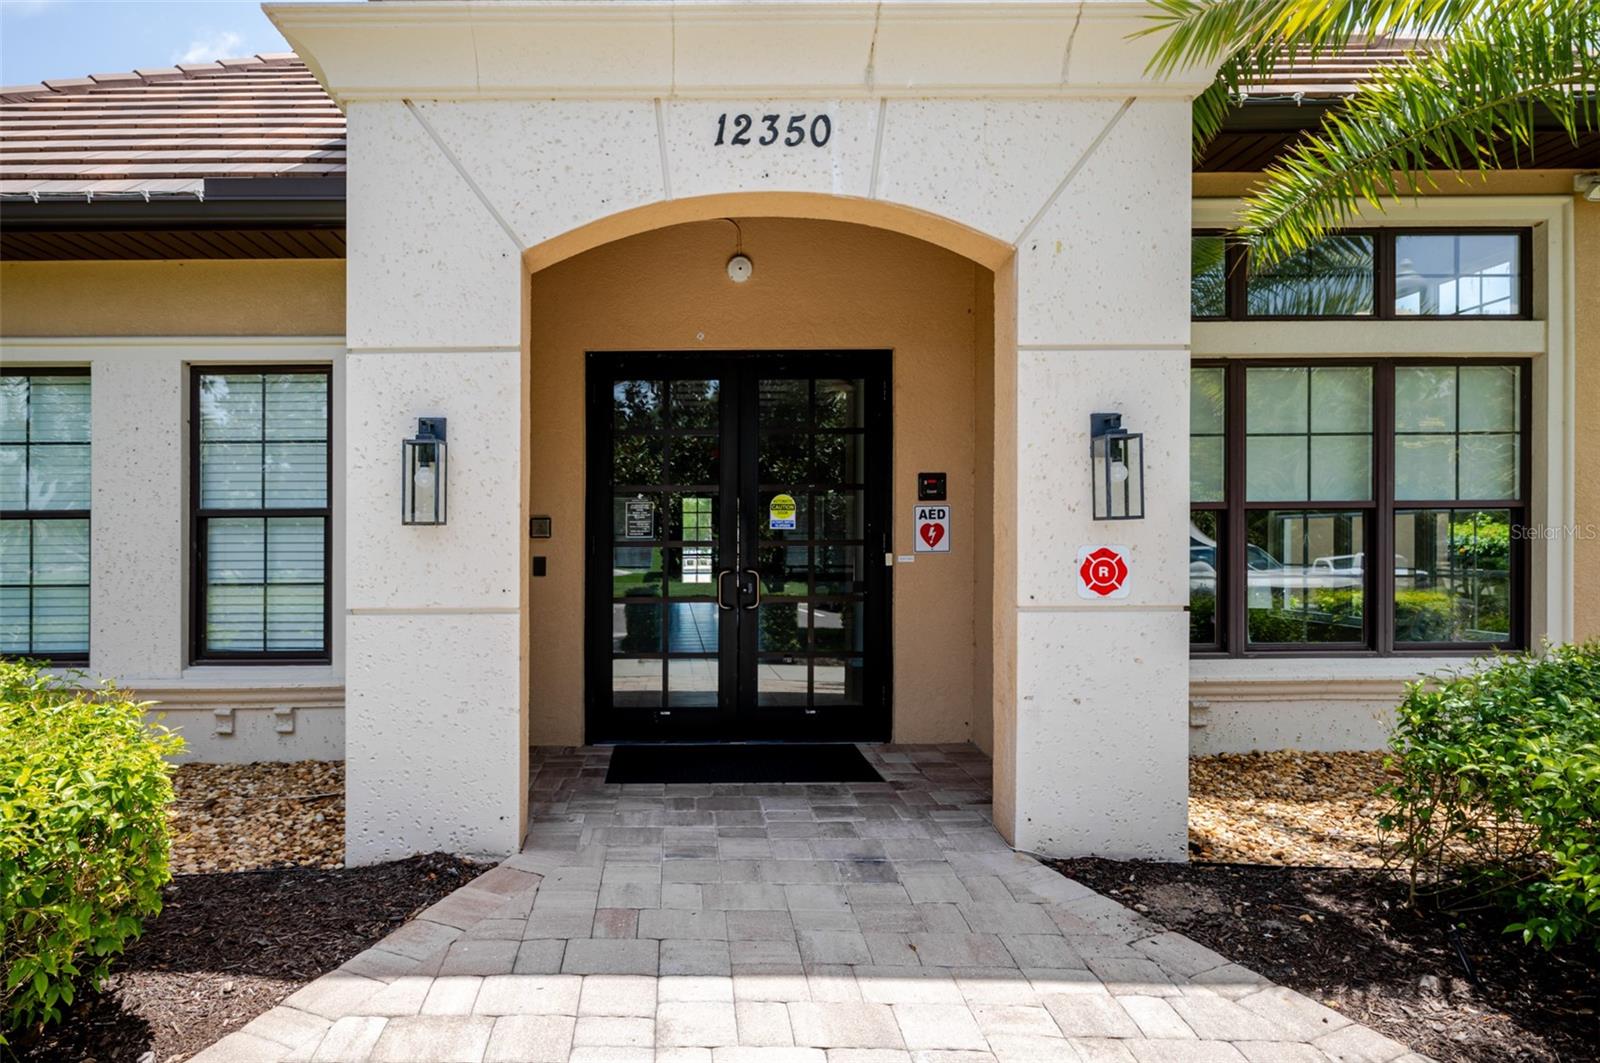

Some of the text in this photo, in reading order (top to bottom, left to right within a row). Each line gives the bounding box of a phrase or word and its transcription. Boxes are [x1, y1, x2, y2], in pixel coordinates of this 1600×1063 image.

[714, 113, 831, 148] 12350
[919, 509, 946, 520] AED
[1098, 566, 1109, 577] R
